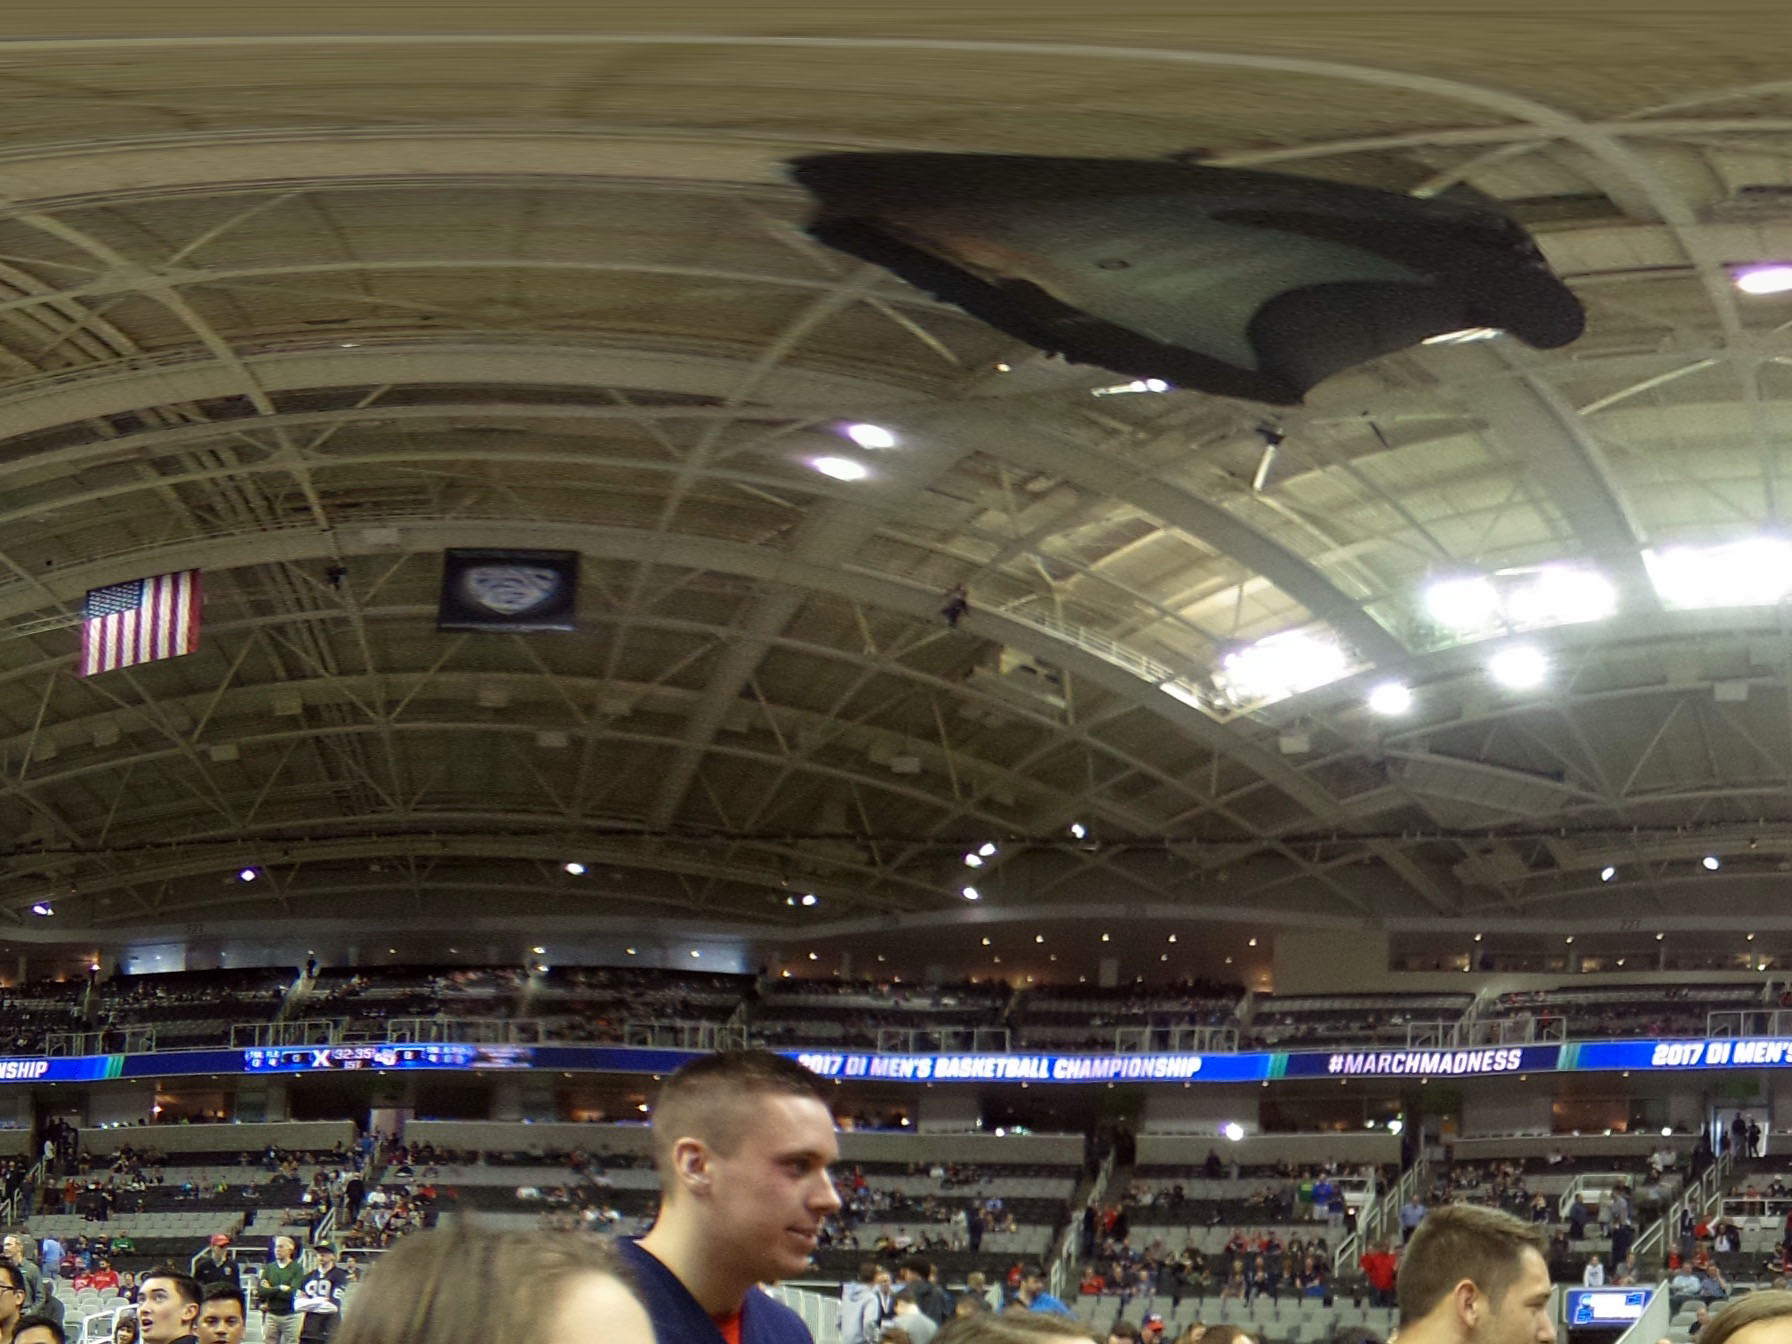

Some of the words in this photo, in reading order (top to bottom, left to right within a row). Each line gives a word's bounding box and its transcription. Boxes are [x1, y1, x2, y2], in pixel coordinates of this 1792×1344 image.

[1328, 1048, 1523, 1075] #MARCHMADNESS
[1652, 1042, 1706, 1066] 2017
[1705, 1041, 1732, 1065] DI
[870, 1056, 932, 1078] MEN'S
[934, 1056, 1049, 1079] BASKETBALL
[1052, 1055, 1202, 1079] CHAMPIONSHIP
